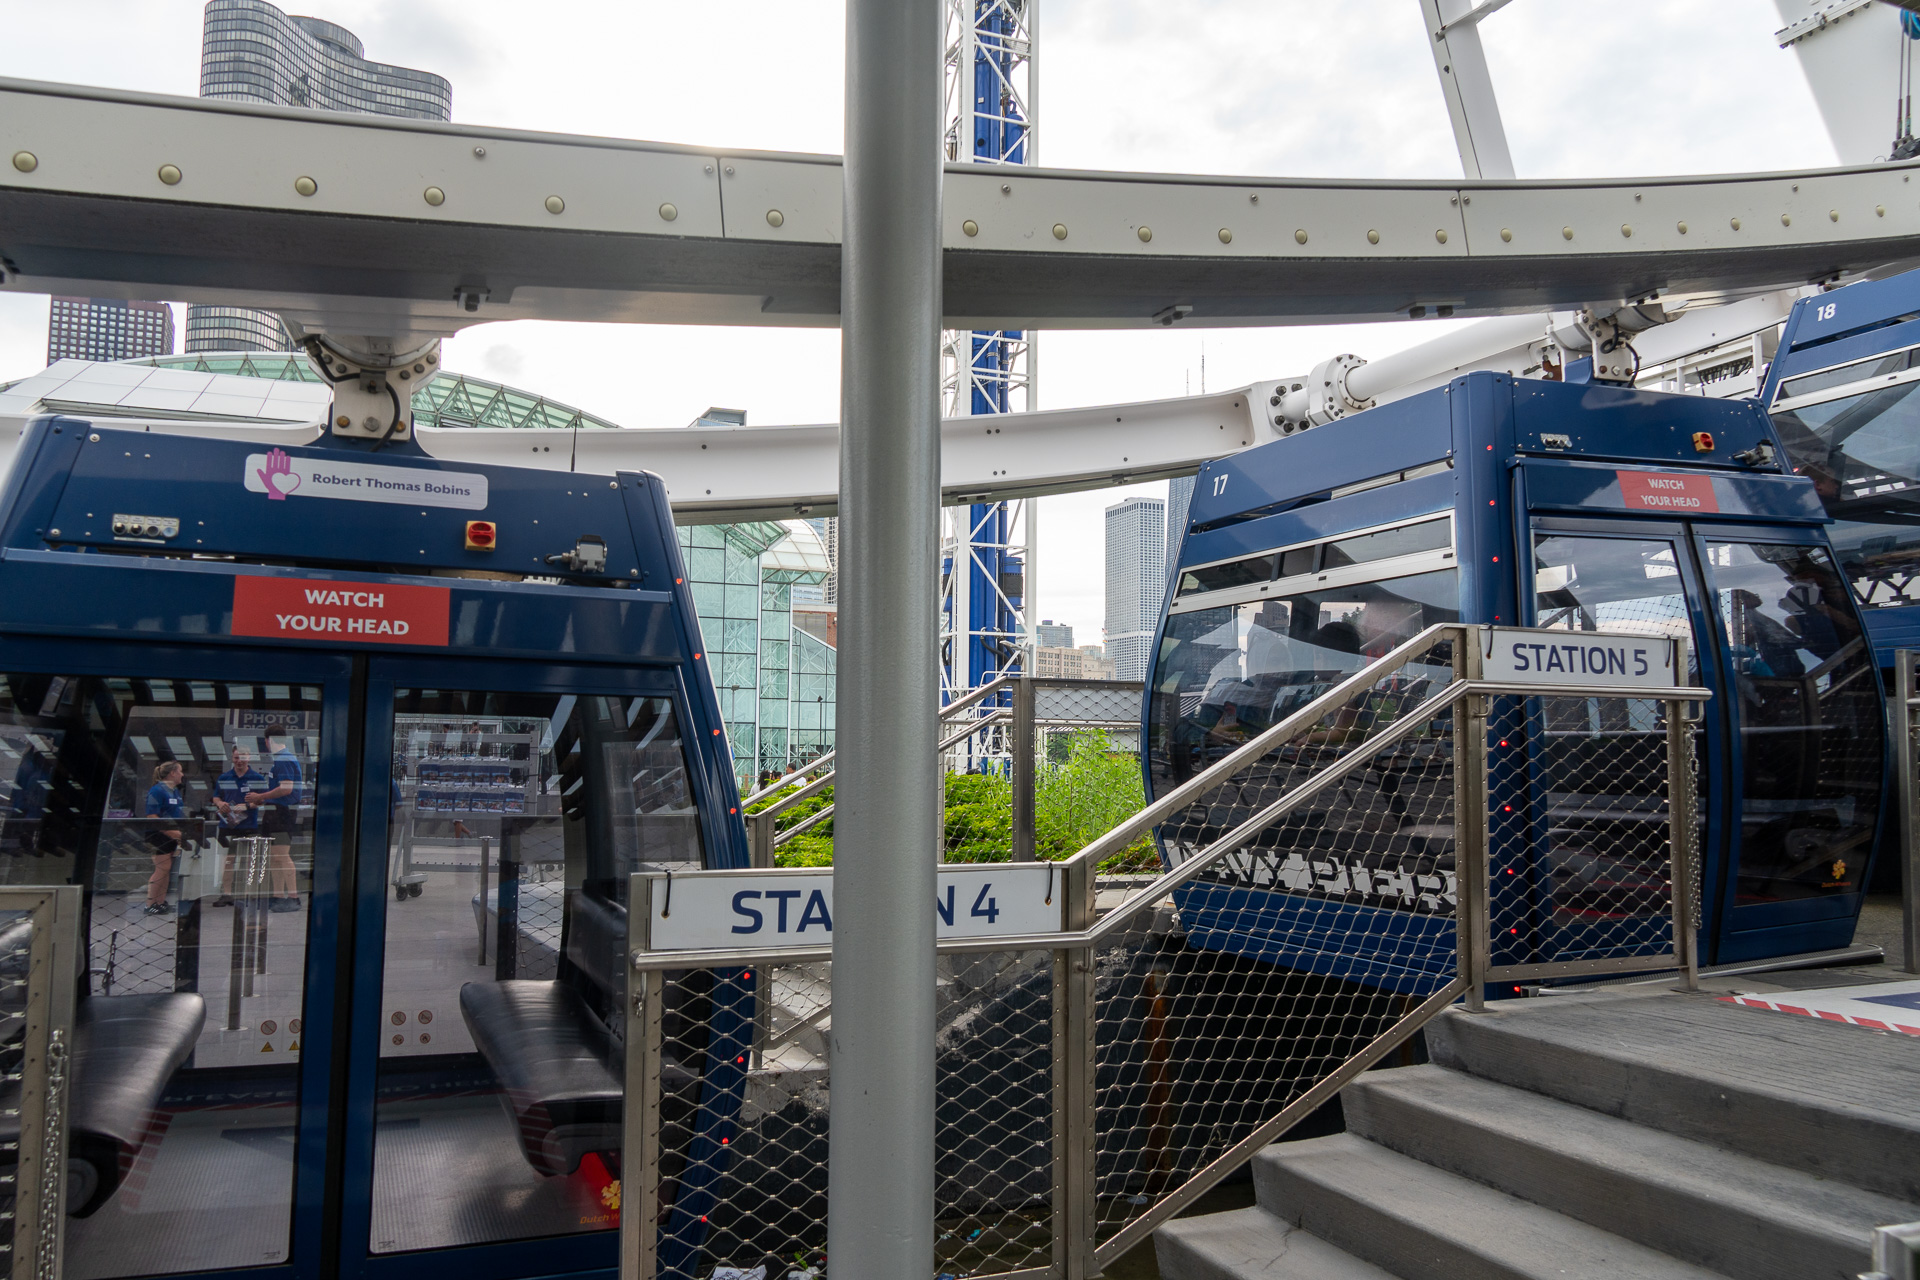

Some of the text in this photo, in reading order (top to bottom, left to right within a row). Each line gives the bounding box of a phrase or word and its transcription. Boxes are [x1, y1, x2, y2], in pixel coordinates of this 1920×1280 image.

[1816, 302, 1837, 322] 18
[312, 472, 471, 496] Robert Thomas Bobins
[1213, 473, 1229, 497] 17
[1647, 478, 1685, 490] WATCH
[1640, 494, 1701, 508] YOUR HEAD
[304, 588, 385, 608] WATCH
[275, 613, 410, 635] YOUR HEAD
[1512, 642, 1649, 676] STATION 5
[243, 712, 299, 725] PHOTO
[731, 883, 1000, 934] STAN 4
[580, 1214, 610, 1224] Dutch
